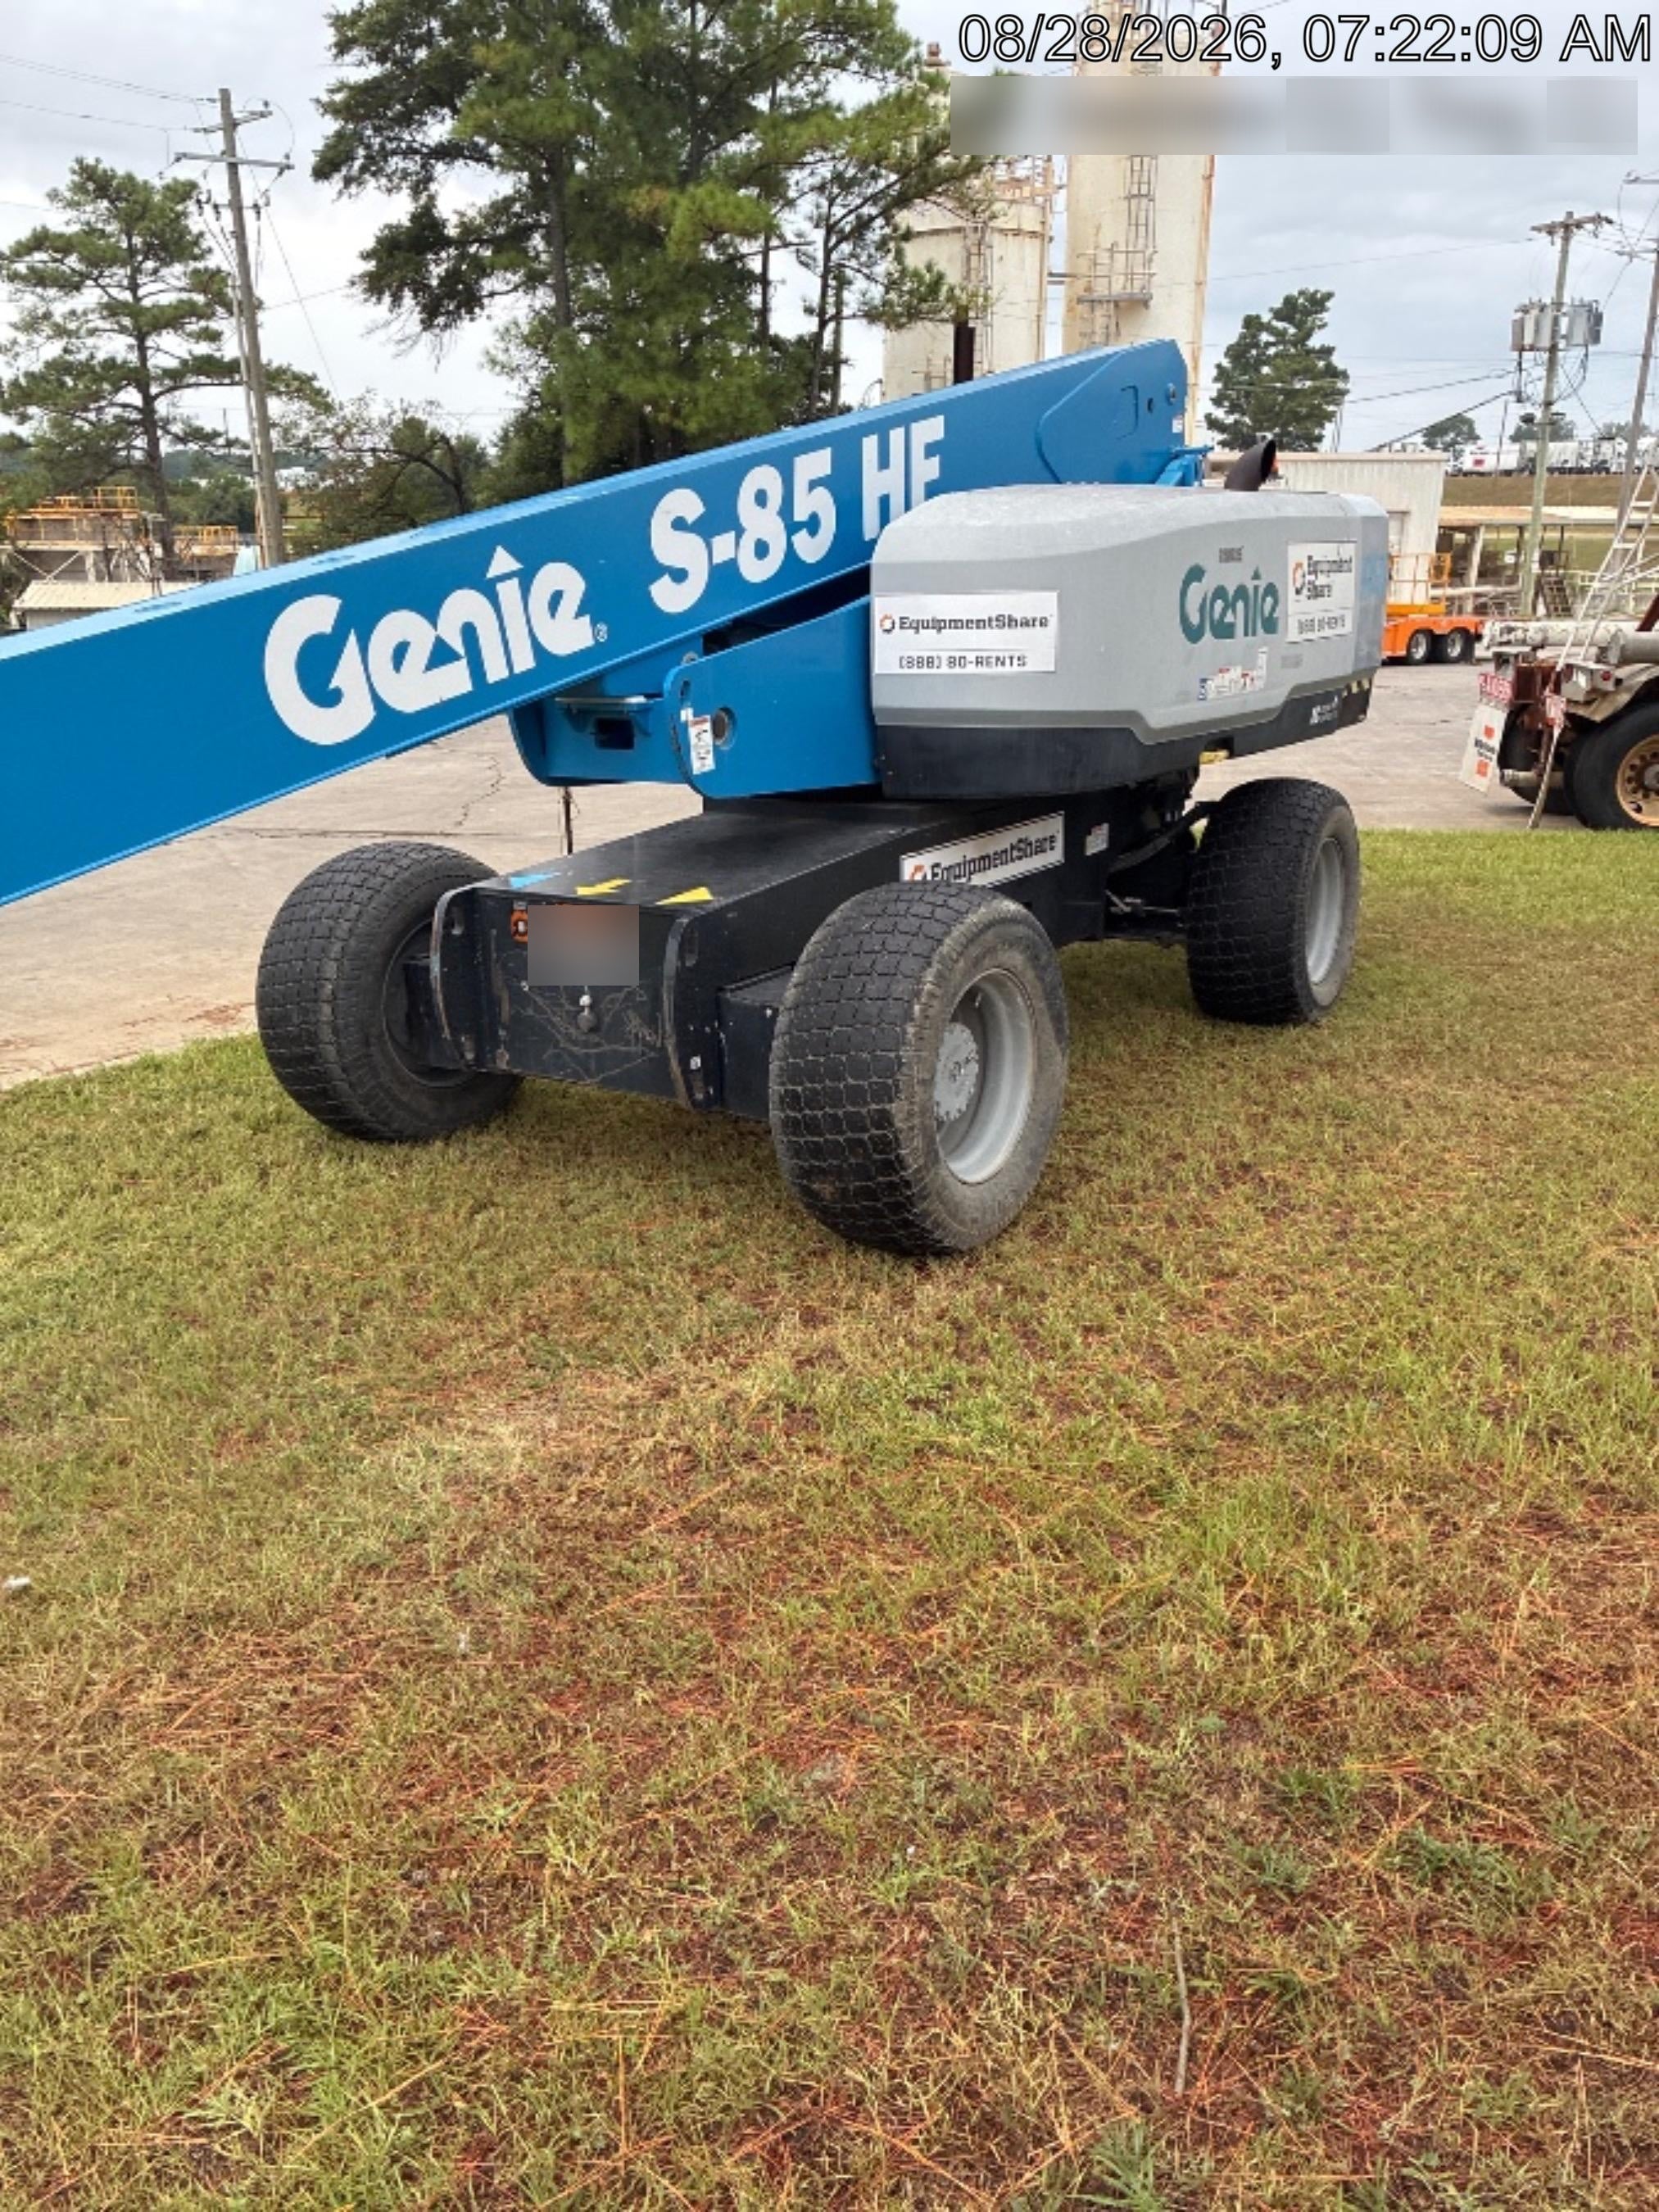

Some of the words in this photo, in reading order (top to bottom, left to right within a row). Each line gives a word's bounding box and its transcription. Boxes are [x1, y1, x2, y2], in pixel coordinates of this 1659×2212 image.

[264, 546, 595, 746] Genie
[649, 447, 836, 614] S-85
[861, 415, 945, 542] HF
[1179, 564, 1279, 644] Genie
[899, 614, 1050, 634] EquipmentShare
